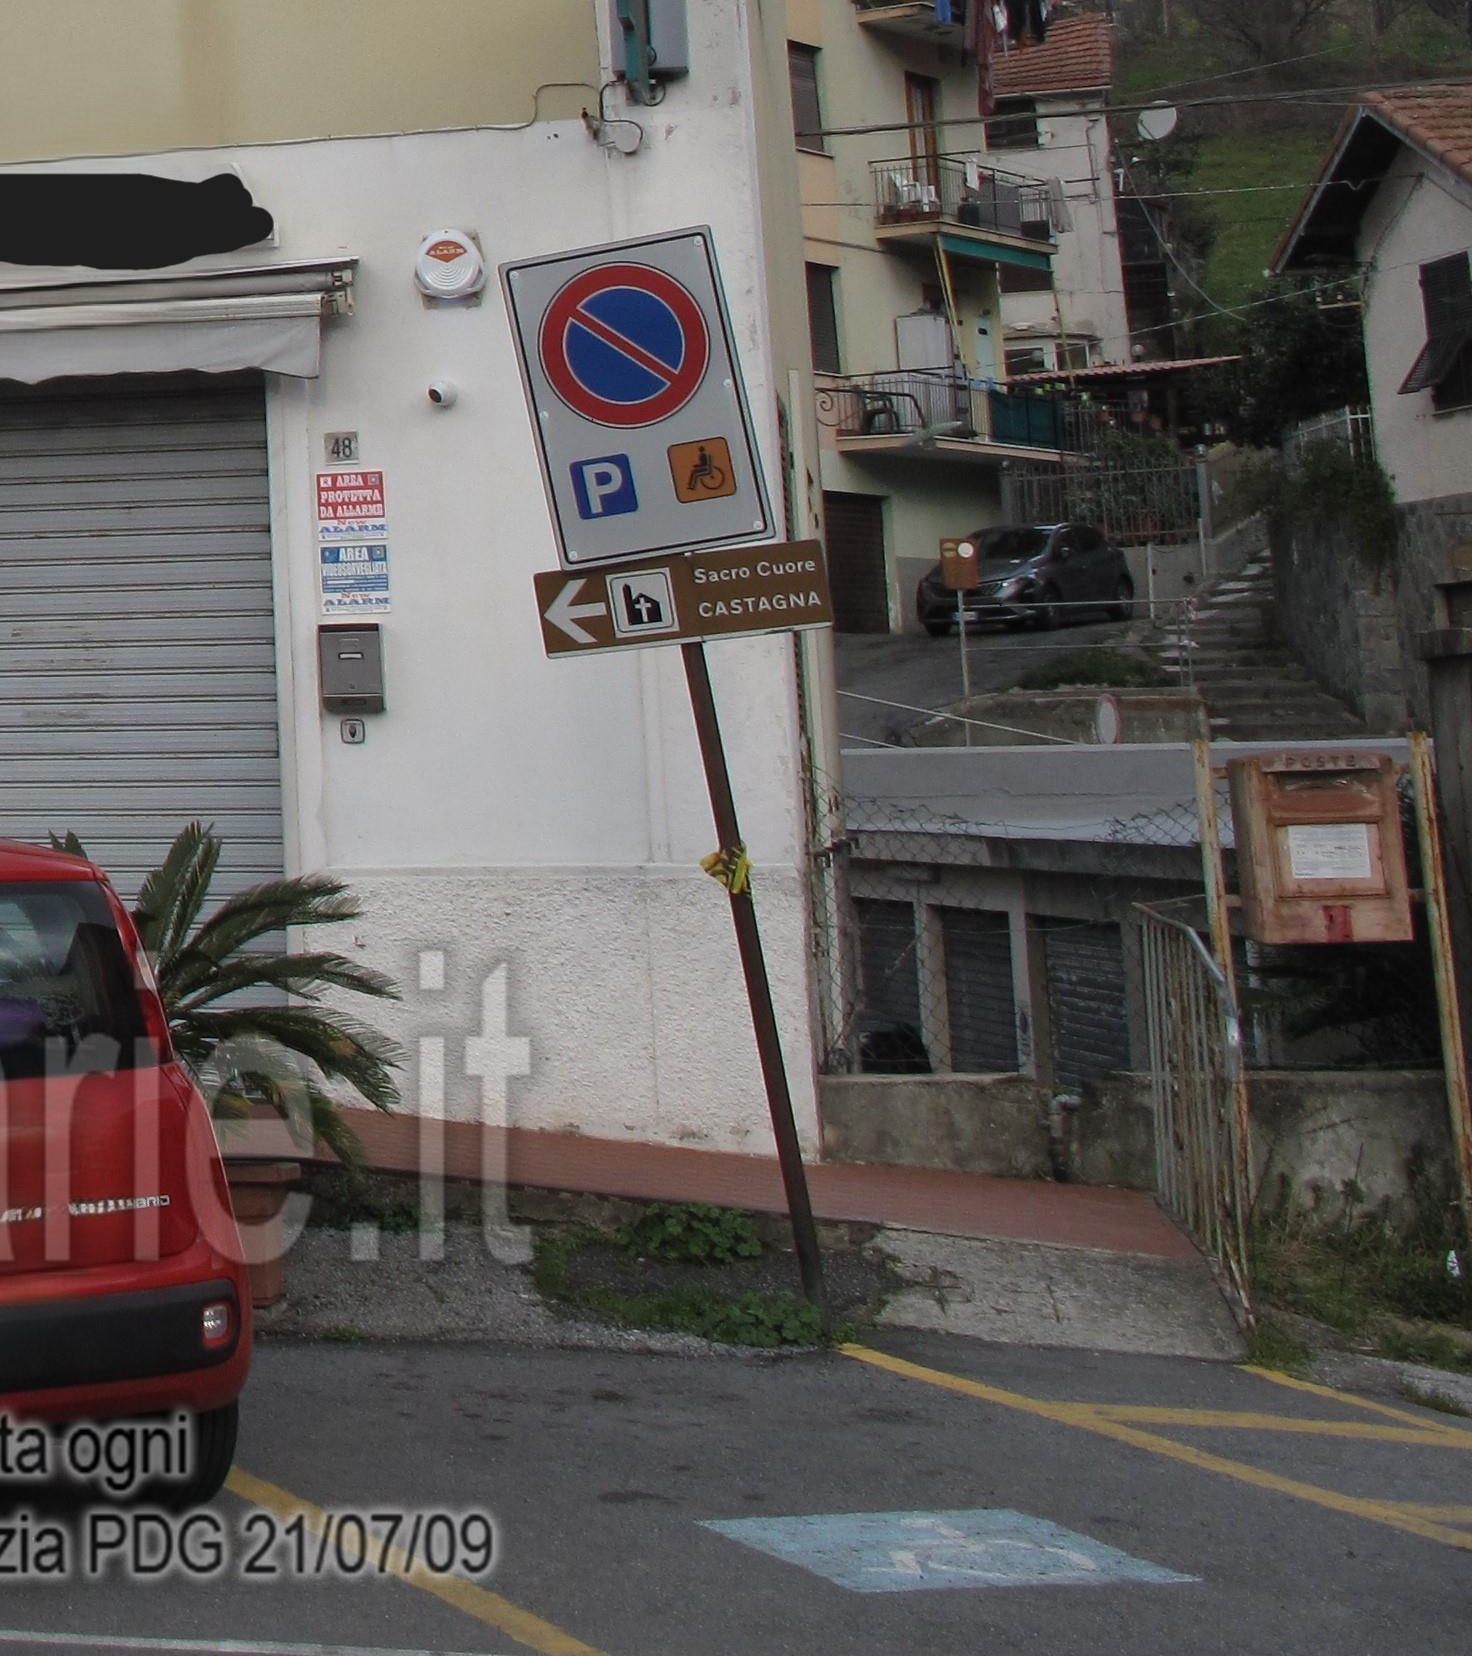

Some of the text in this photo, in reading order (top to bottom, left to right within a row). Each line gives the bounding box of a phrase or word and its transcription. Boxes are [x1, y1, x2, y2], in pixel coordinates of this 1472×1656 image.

[332, 437, 353, 458] 48
[336, 474, 364, 487] AREA
[581, 462, 623, 514] P
[319, 489, 382, 503] PROTETTA
[319, 504, 383, 518] DA ALLARME
[339, 547, 369, 561] AREA
[694, 559, 816, 584] Sacro Cuore
[699, 591, 821, 618] CASTAGNA
